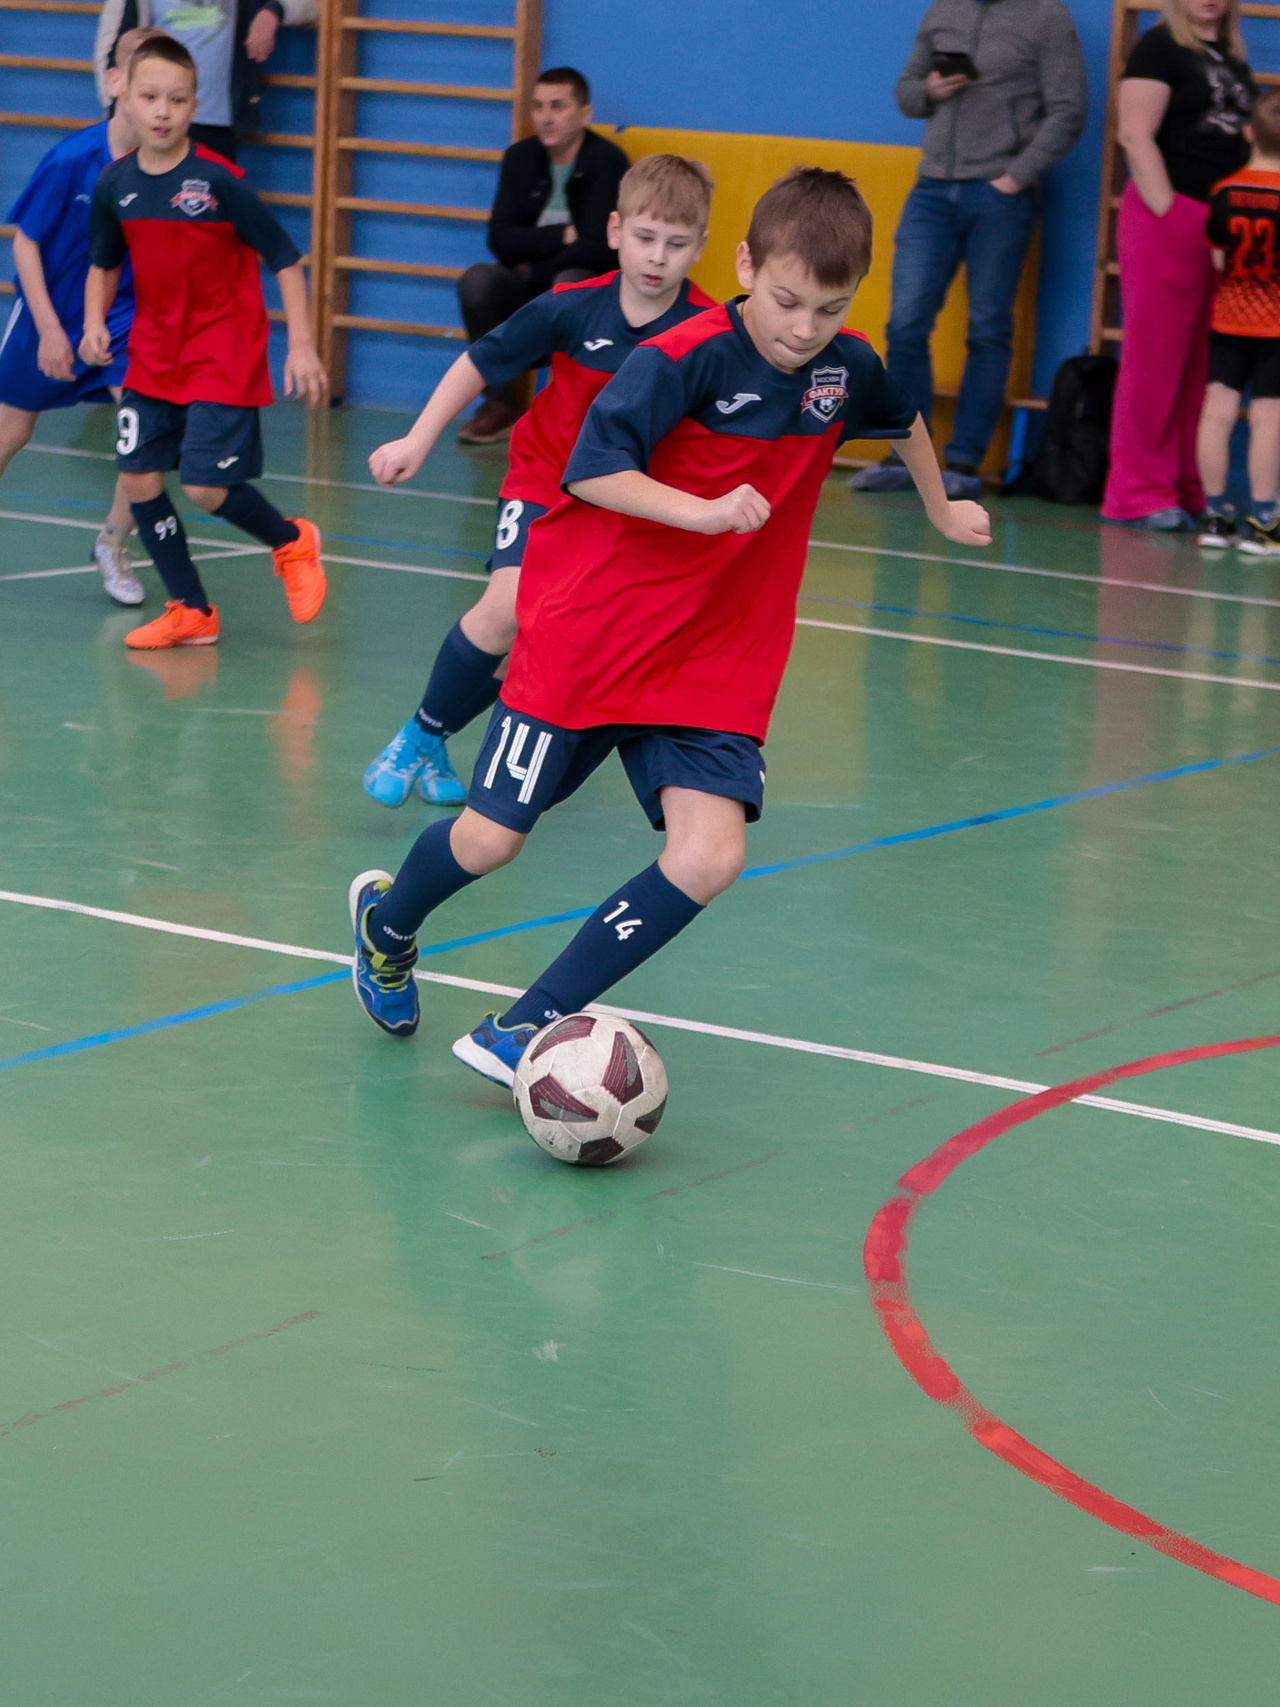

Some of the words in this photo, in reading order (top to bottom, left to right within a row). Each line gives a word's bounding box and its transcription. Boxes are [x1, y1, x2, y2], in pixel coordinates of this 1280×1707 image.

[1228, 215, 1276, 281] 23
[115, 406, 140, 456] 9
[154, 515, 178, 541] 99
[495, 499, 525, 551] 8
[482, 715, 553, 805] 14
[603, 900, 643, 941] 14
